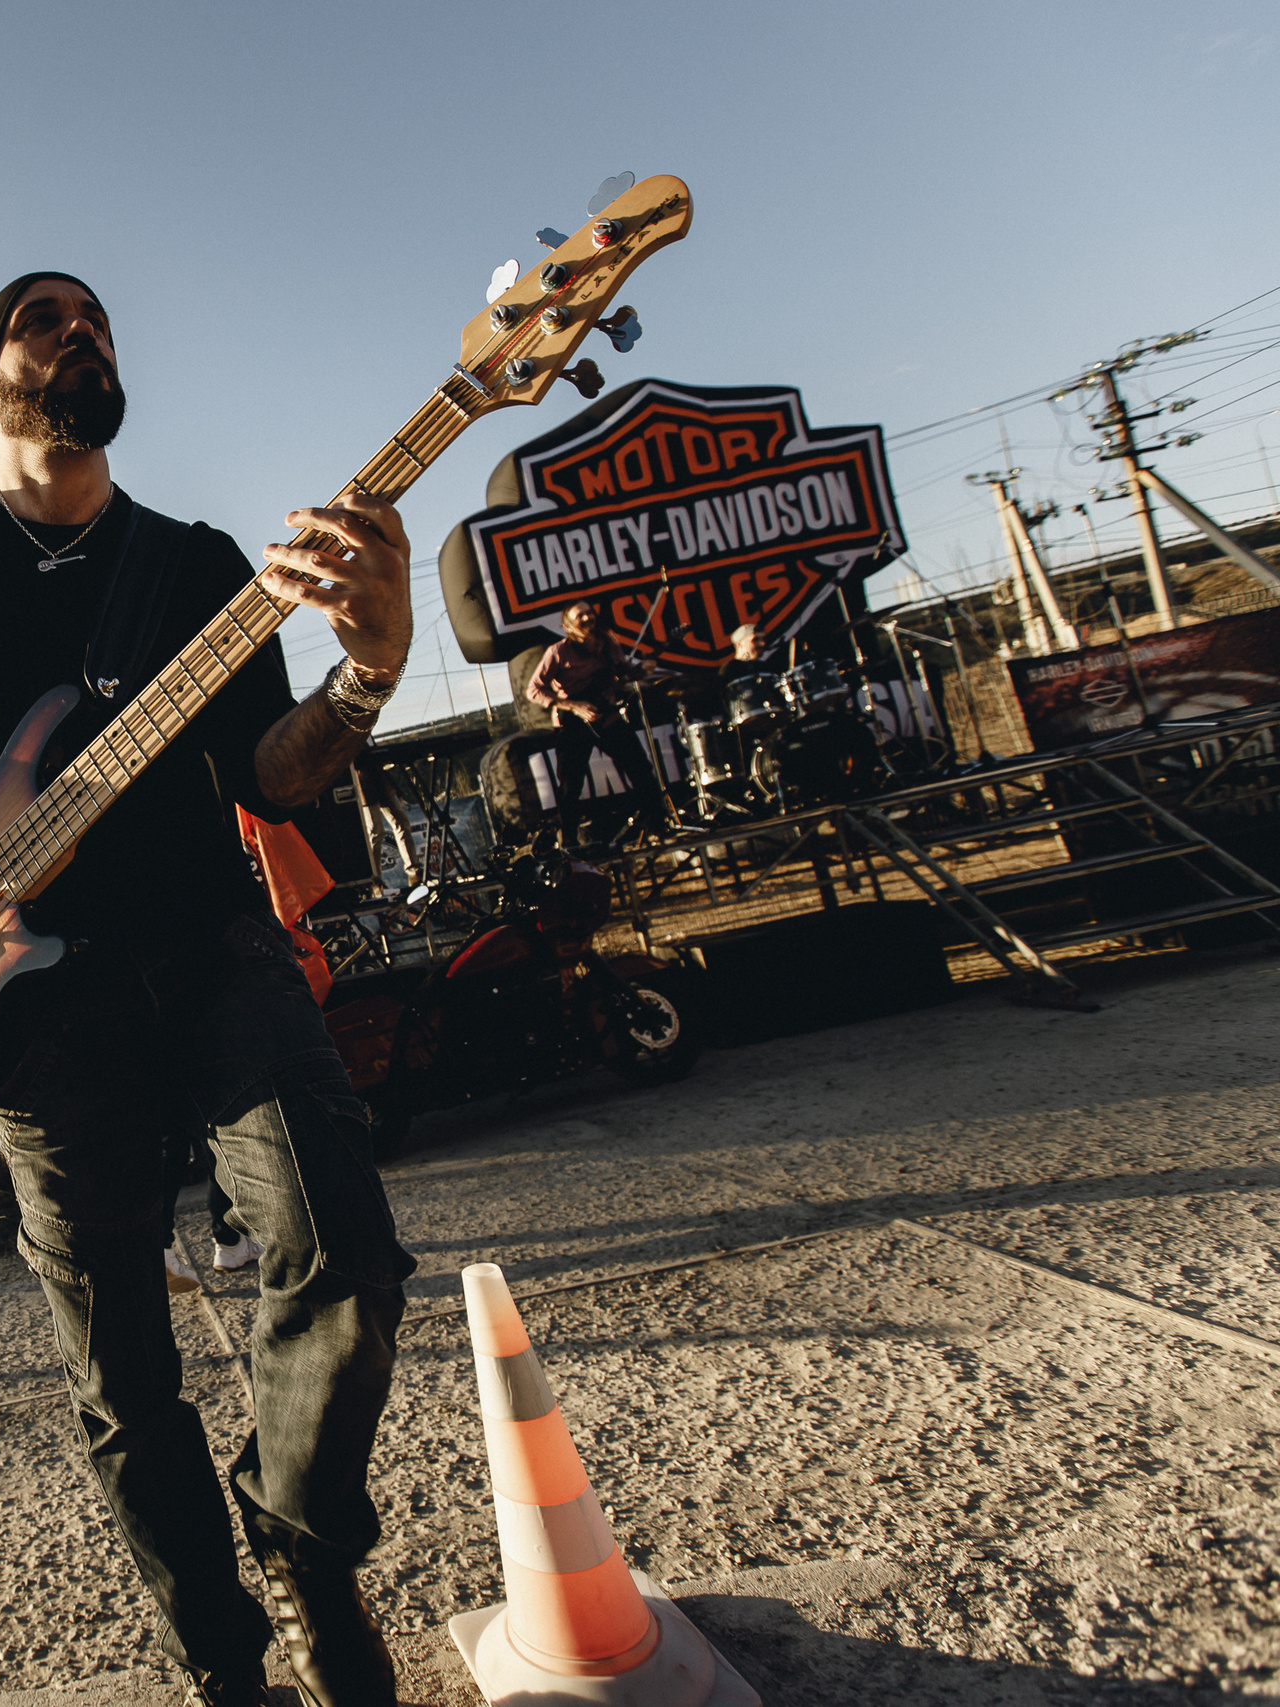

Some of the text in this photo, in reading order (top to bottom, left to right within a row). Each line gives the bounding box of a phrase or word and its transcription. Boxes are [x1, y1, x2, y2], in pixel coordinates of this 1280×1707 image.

[578, 421, 762, 500] MOTOR
[513, 470, 857, 597] HARLEY-DAVIDSON
[610, 562, 792, 652] CYCLES
